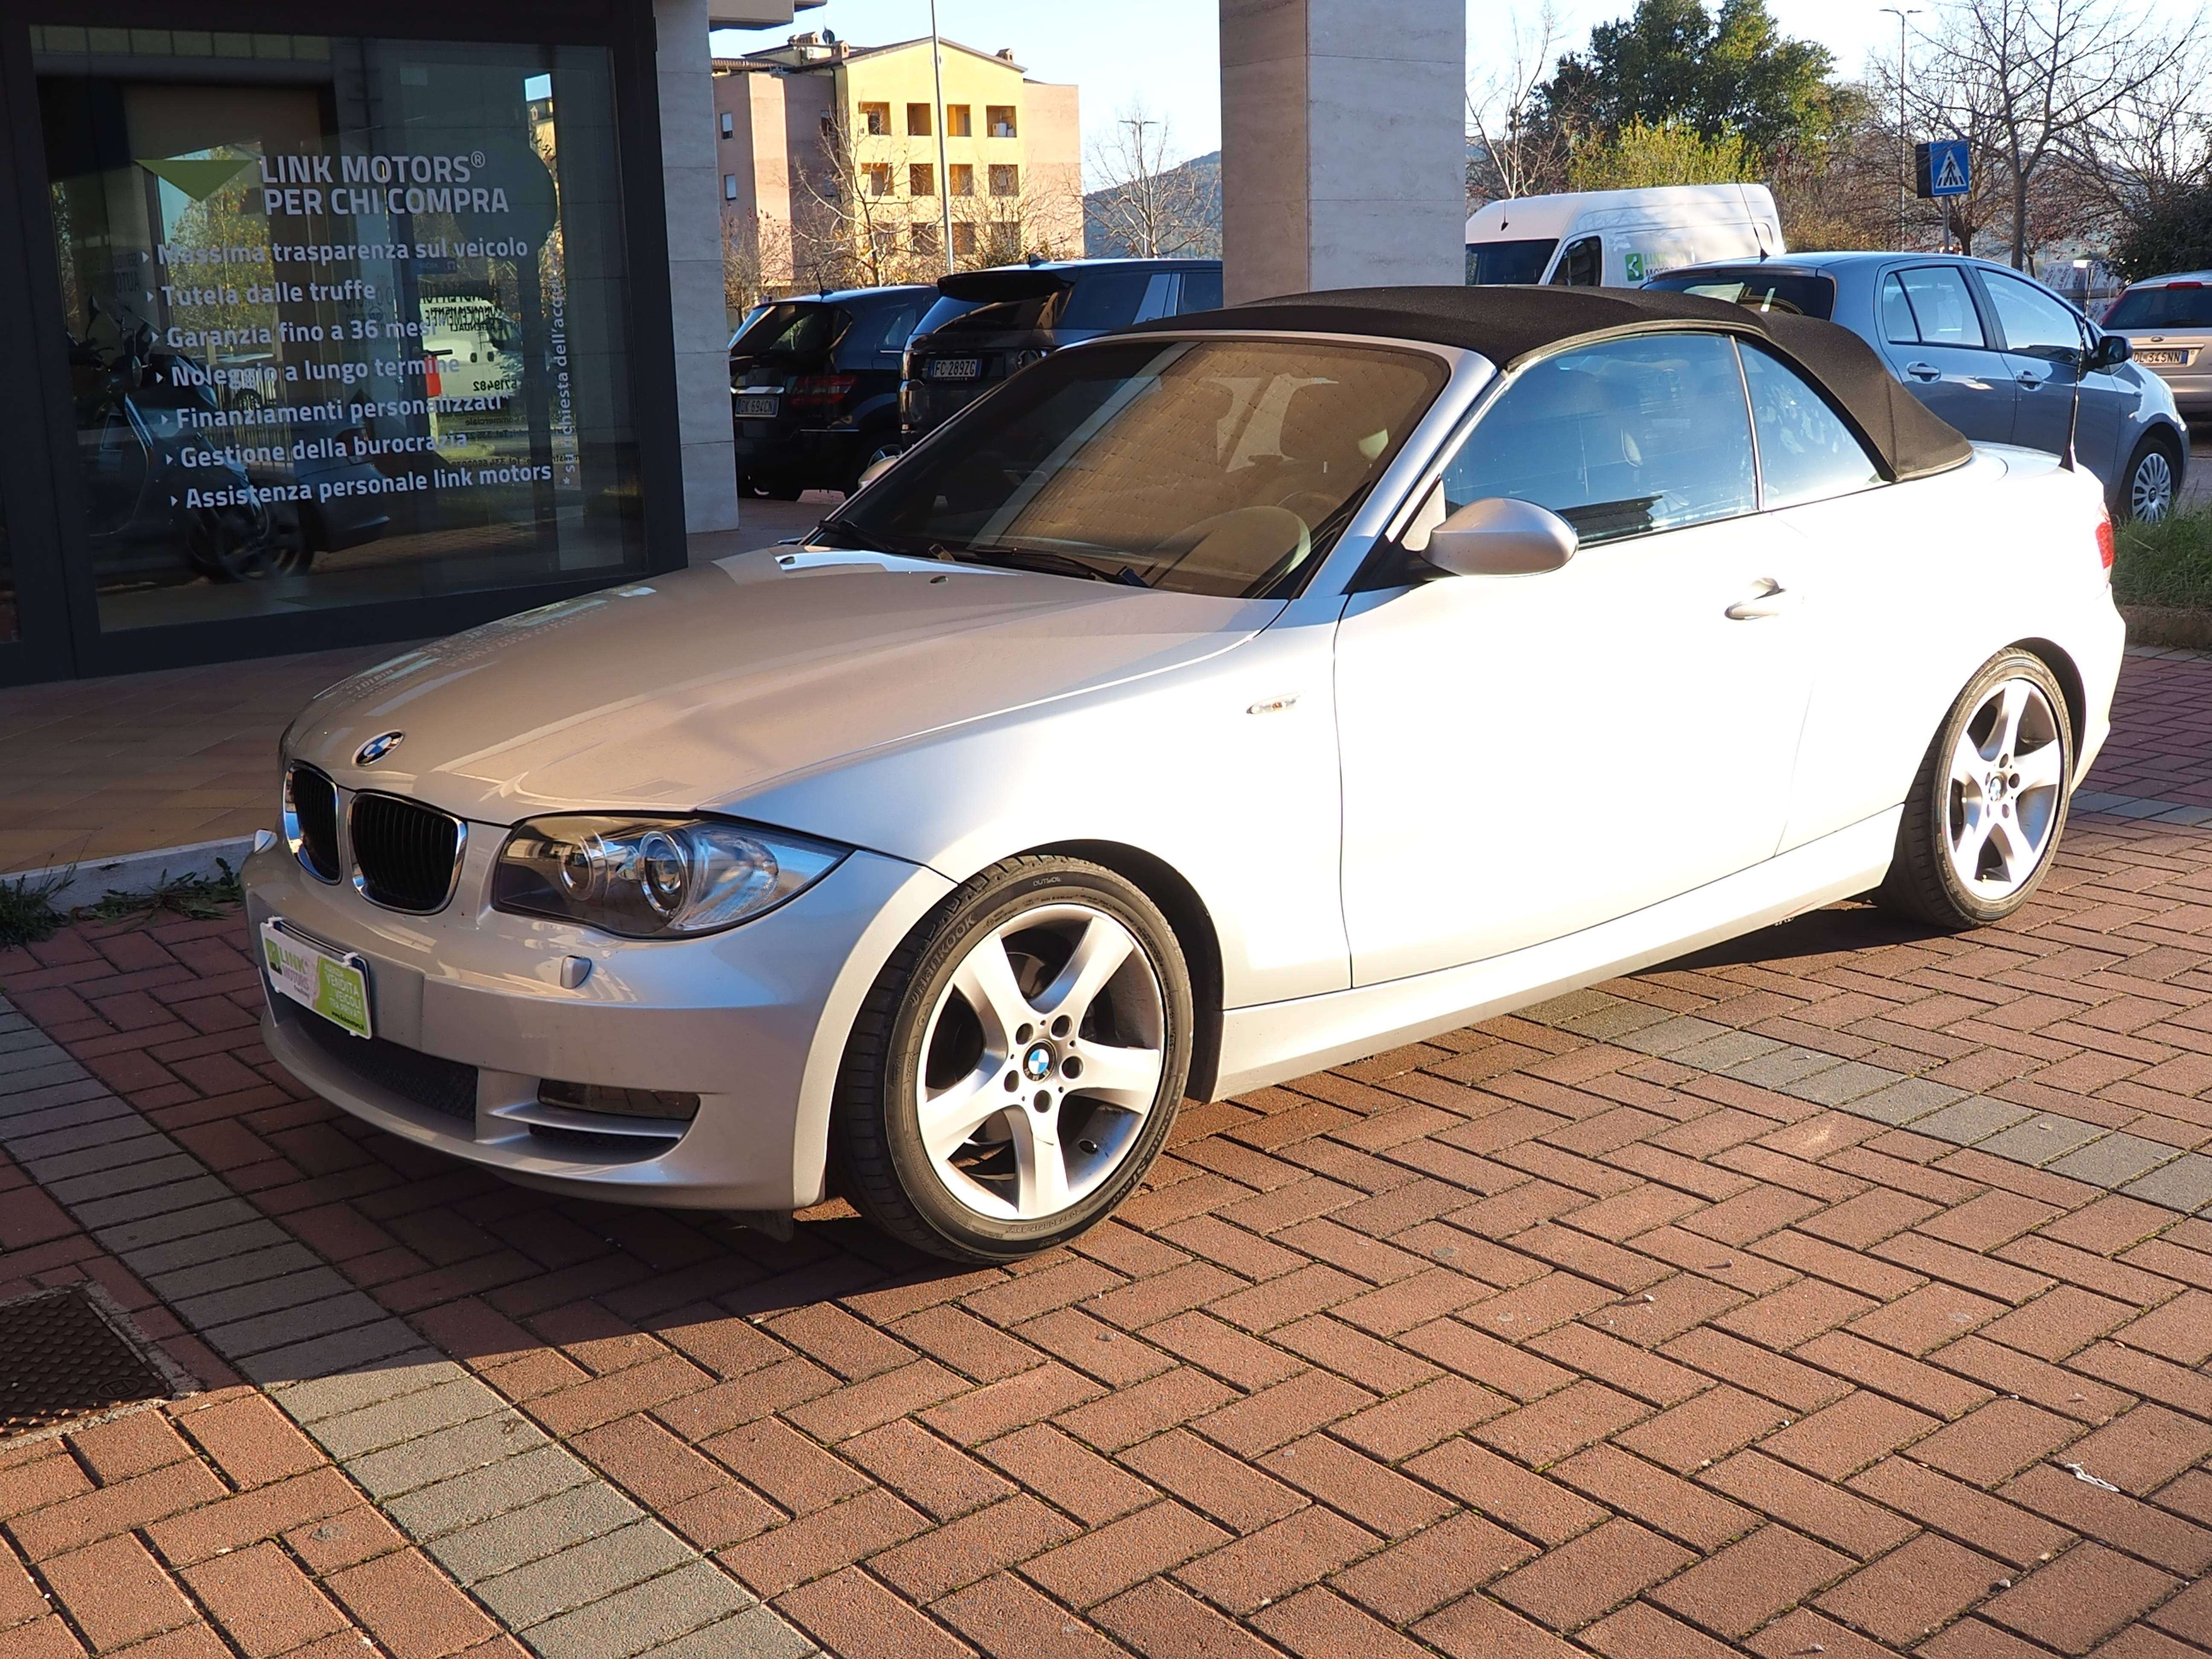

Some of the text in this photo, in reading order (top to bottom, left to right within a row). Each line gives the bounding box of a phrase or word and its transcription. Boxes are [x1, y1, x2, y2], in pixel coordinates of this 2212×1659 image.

[261, 155, 334, 183] LINK
[264, 188, 509, 215] PER CHI COMPRA
[157, 243, 265, 265] Massima
[273, 242, 409, 266] trasparenza
[416, 237, 448, 258] sul
[454, 237, 528, 257] veicolo
[160, 283, 239, 307] Tutela
[245, 282, 303, 303] dalle
[309, 279, 376, 302] truffe
[166, 324, 272, 348] Garanzia
[279, 321, 324, 342] fino
[331, 325, 343, 340] a
[351, 319, 378, 339] 36
[935, 361, 975, 375] FC 289ZG
[2133, 352, 2180, 362] DL 345NN
[171, 355, 460, 390] Noleggio a lungo termine
[176, 399, 343, 429] Finanziamenti
[557, 372, 573, 448] richiesta
[181, 430, 467, 468] Gestione della burocrazia
[186, 464, 552, 509] Assistenza personale link motors
